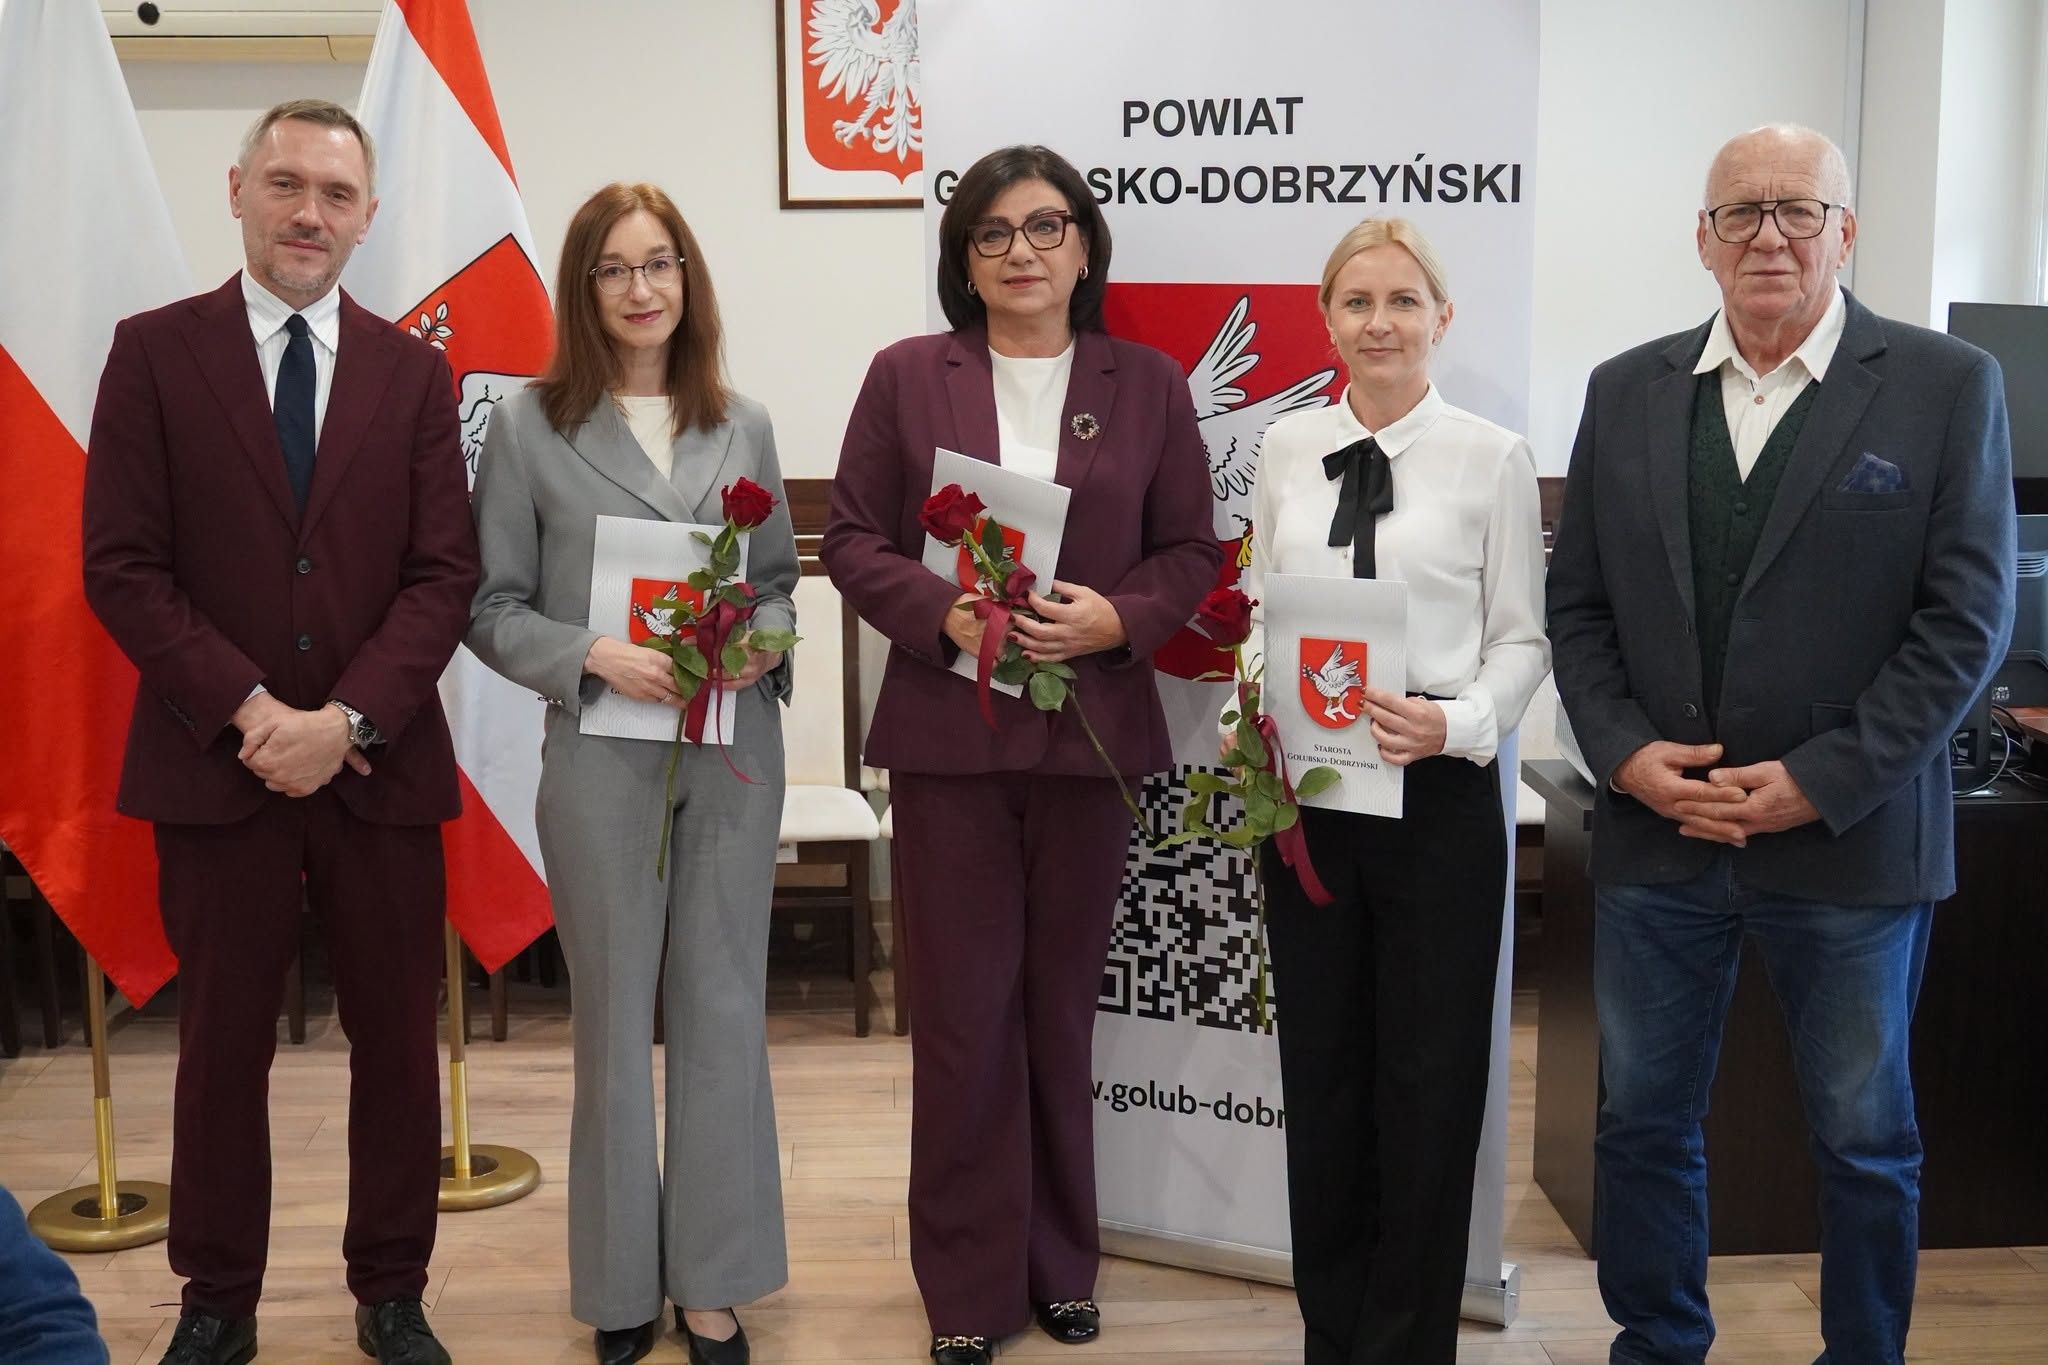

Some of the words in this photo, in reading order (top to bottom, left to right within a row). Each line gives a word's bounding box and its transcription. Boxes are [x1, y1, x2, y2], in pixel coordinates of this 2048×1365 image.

[1123, 96, 1304, 138] POWIAT
[934, 153, 1522, 205] GSKO-DOBRZYŃSKI
[1314, 743, 1352, 756] STAROSTA
